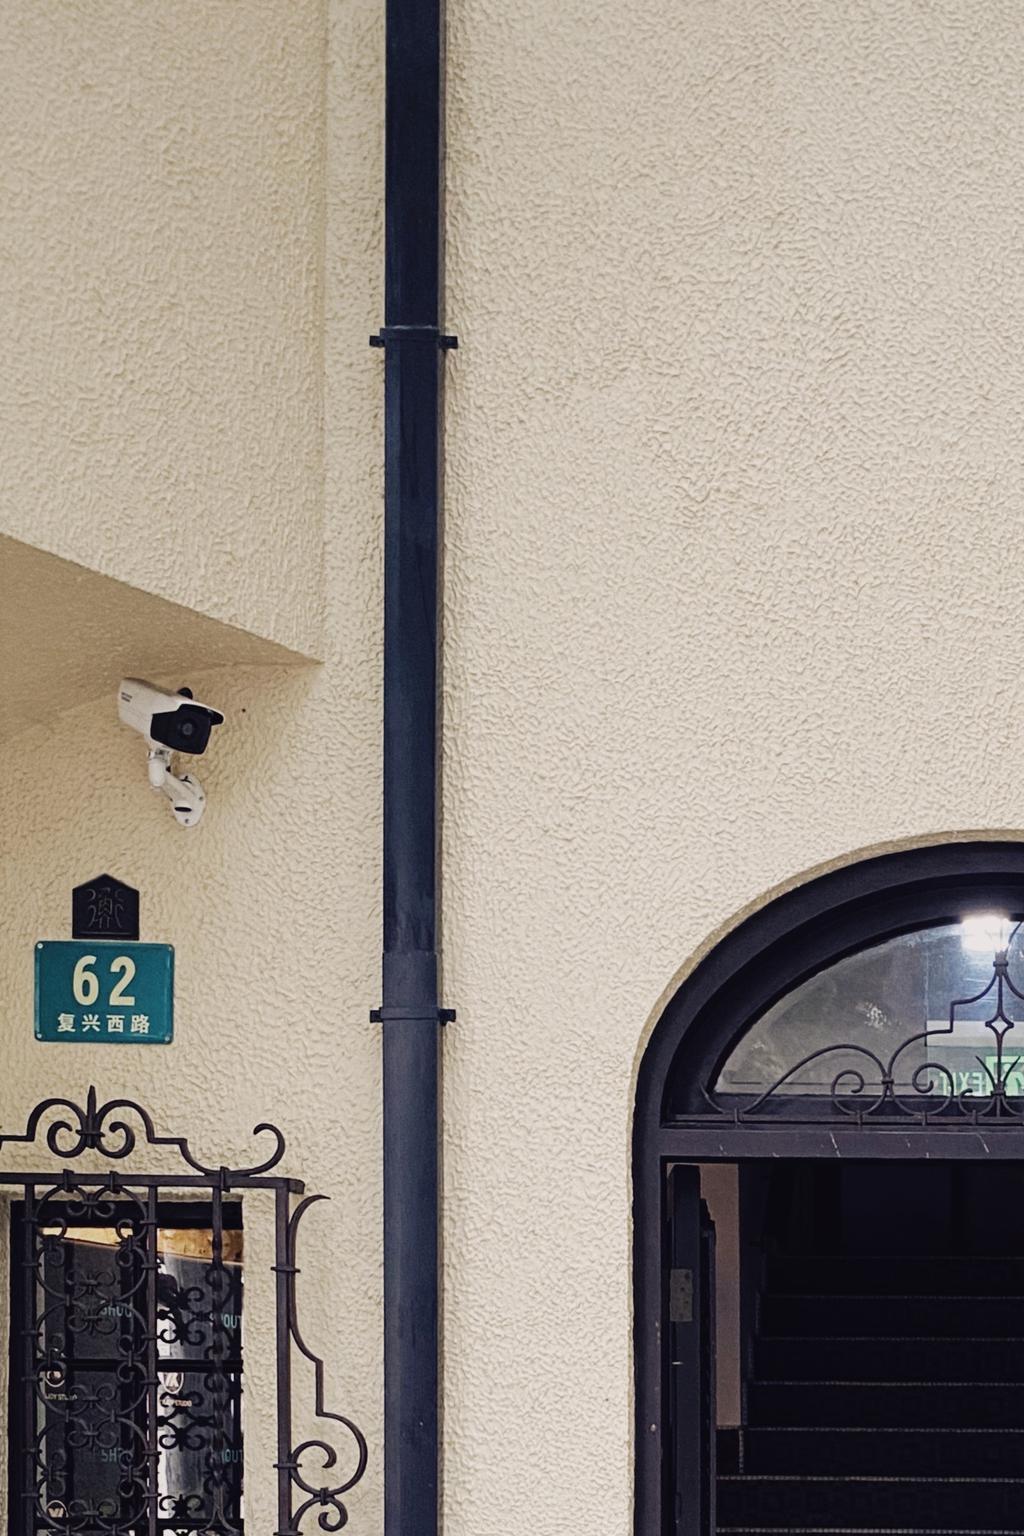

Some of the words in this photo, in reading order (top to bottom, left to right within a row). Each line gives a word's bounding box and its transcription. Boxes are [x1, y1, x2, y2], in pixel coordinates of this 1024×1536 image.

[72, 955, 136, 1007] 62
[57, 1013, 150, 1034] 复兴西路
